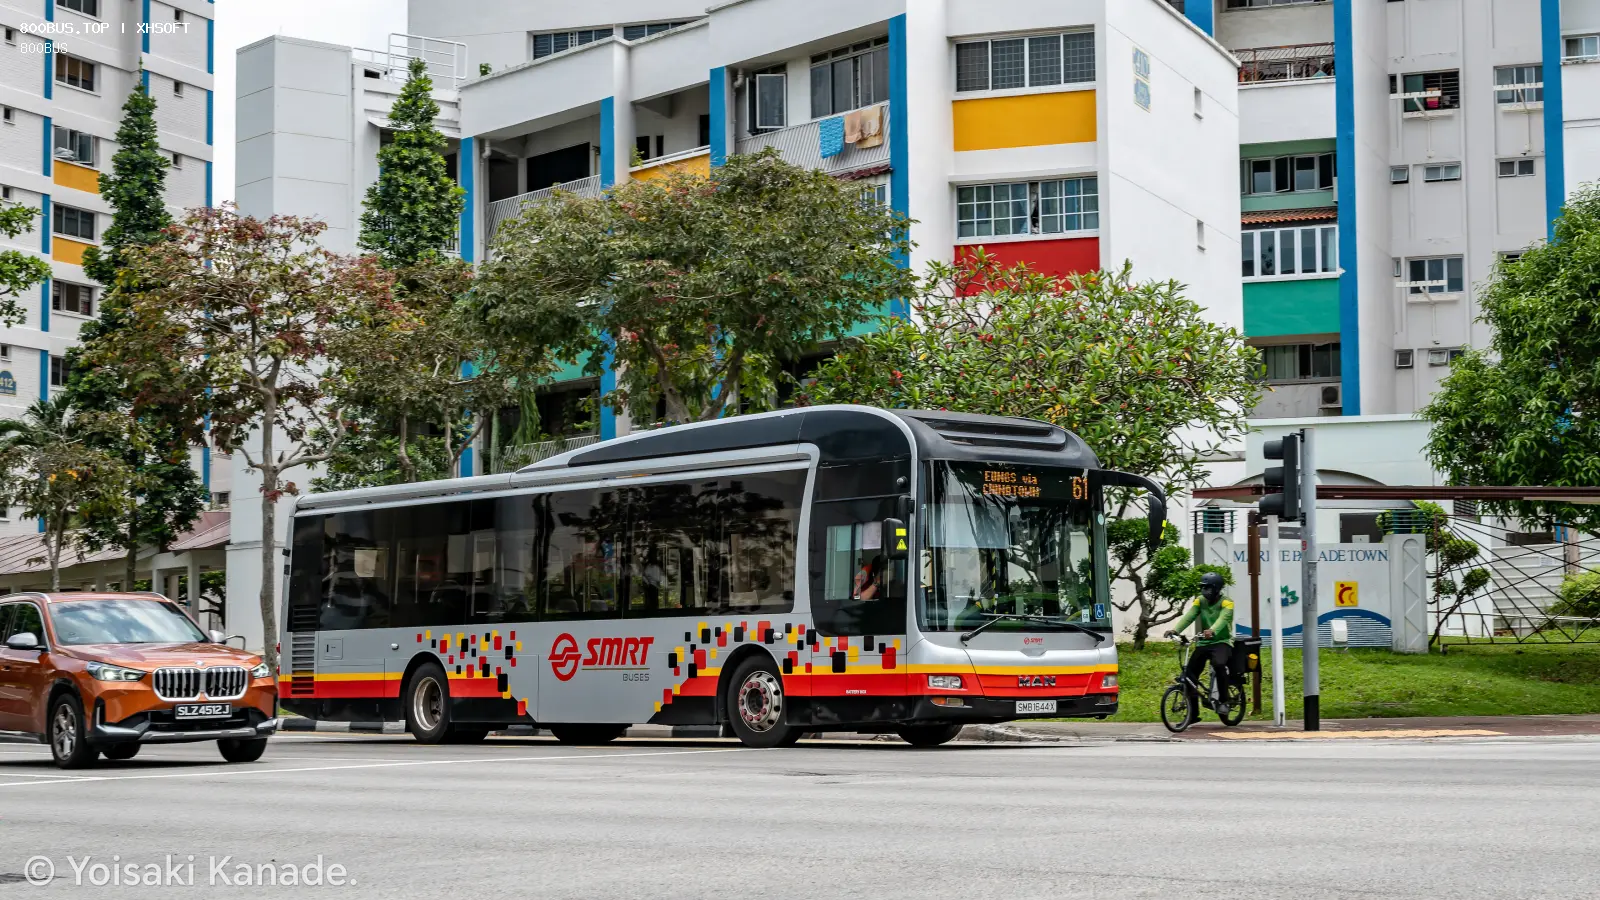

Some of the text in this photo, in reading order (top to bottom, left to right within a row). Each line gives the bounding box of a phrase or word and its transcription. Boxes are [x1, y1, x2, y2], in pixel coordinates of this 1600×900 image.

[1021, 473, 1038, 485] via
[1072, 476, 1088, 500] 61
[1233, 549, 1389, 562] MRIE PADE TOWN
[581, 637, 655, 666] SMRT
[622, 673, 650, 682] BUSES
[1018, 675, 1057, 688] MAN
[176, 705, 231, 718] SLZ4512J
[1017, 703, 1056, 713] SMB1644X
